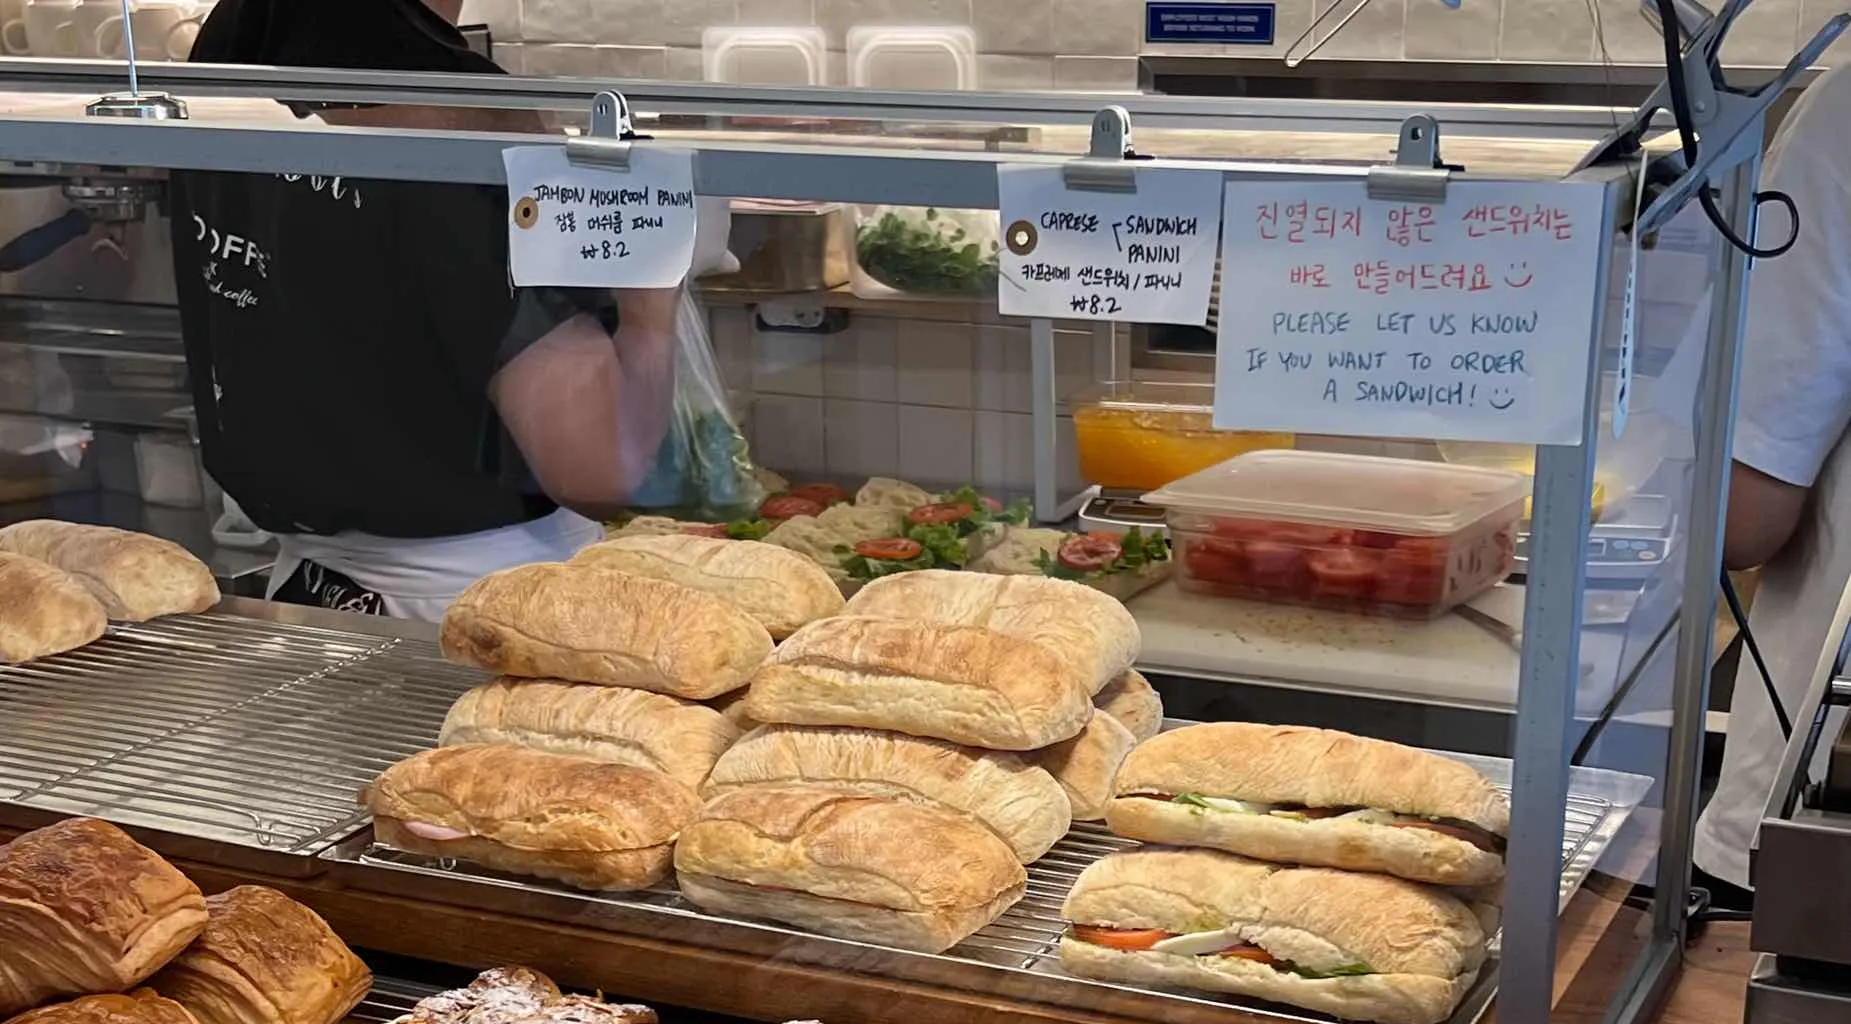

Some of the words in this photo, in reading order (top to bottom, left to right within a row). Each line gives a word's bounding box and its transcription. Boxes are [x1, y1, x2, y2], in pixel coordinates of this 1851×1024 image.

[533, 184, 585, 203] JAMBON
[590, 186, 649, 208] MUSHROOM
[657, 189, 693, 209] PANINI
[587, 211, 623, 234] 머쉬룸
[632, 216, 663, 230] 파니니
[1040, 211, 1100, 233] CAPRESE
[1126, 215, 1198, 236] SANDWICH
[1256, 201, 1361, 243] 진열되지
[1386, 205, 1436, 247] 않은
[1462, 204, 1572, 240] 샌드위치는
[1128, 244, 1180, 264] PANINI
[1290, 264, 1332, 288] 바로
[1354, 260, 1492, 294] 만들어드려요
[1273, 311, 1352, 335] PLEASE
[1377, 312, 1415, 335] LET
[1430, 314, 1456, 336] US
[1472, 311, 1538, 334] KNOW
[1247, 348, 1268, 373] IF
[1279, 352, 1312, 372] YOU
[1328, 351, 1388, 372] WANT
[1408, 352, 1432, 371] TO
[1451, 350, 1526, 374] ORDER
[1323, 379, 1337, 403] A
[1355, 381, 1477, 408] SANDWICH!
